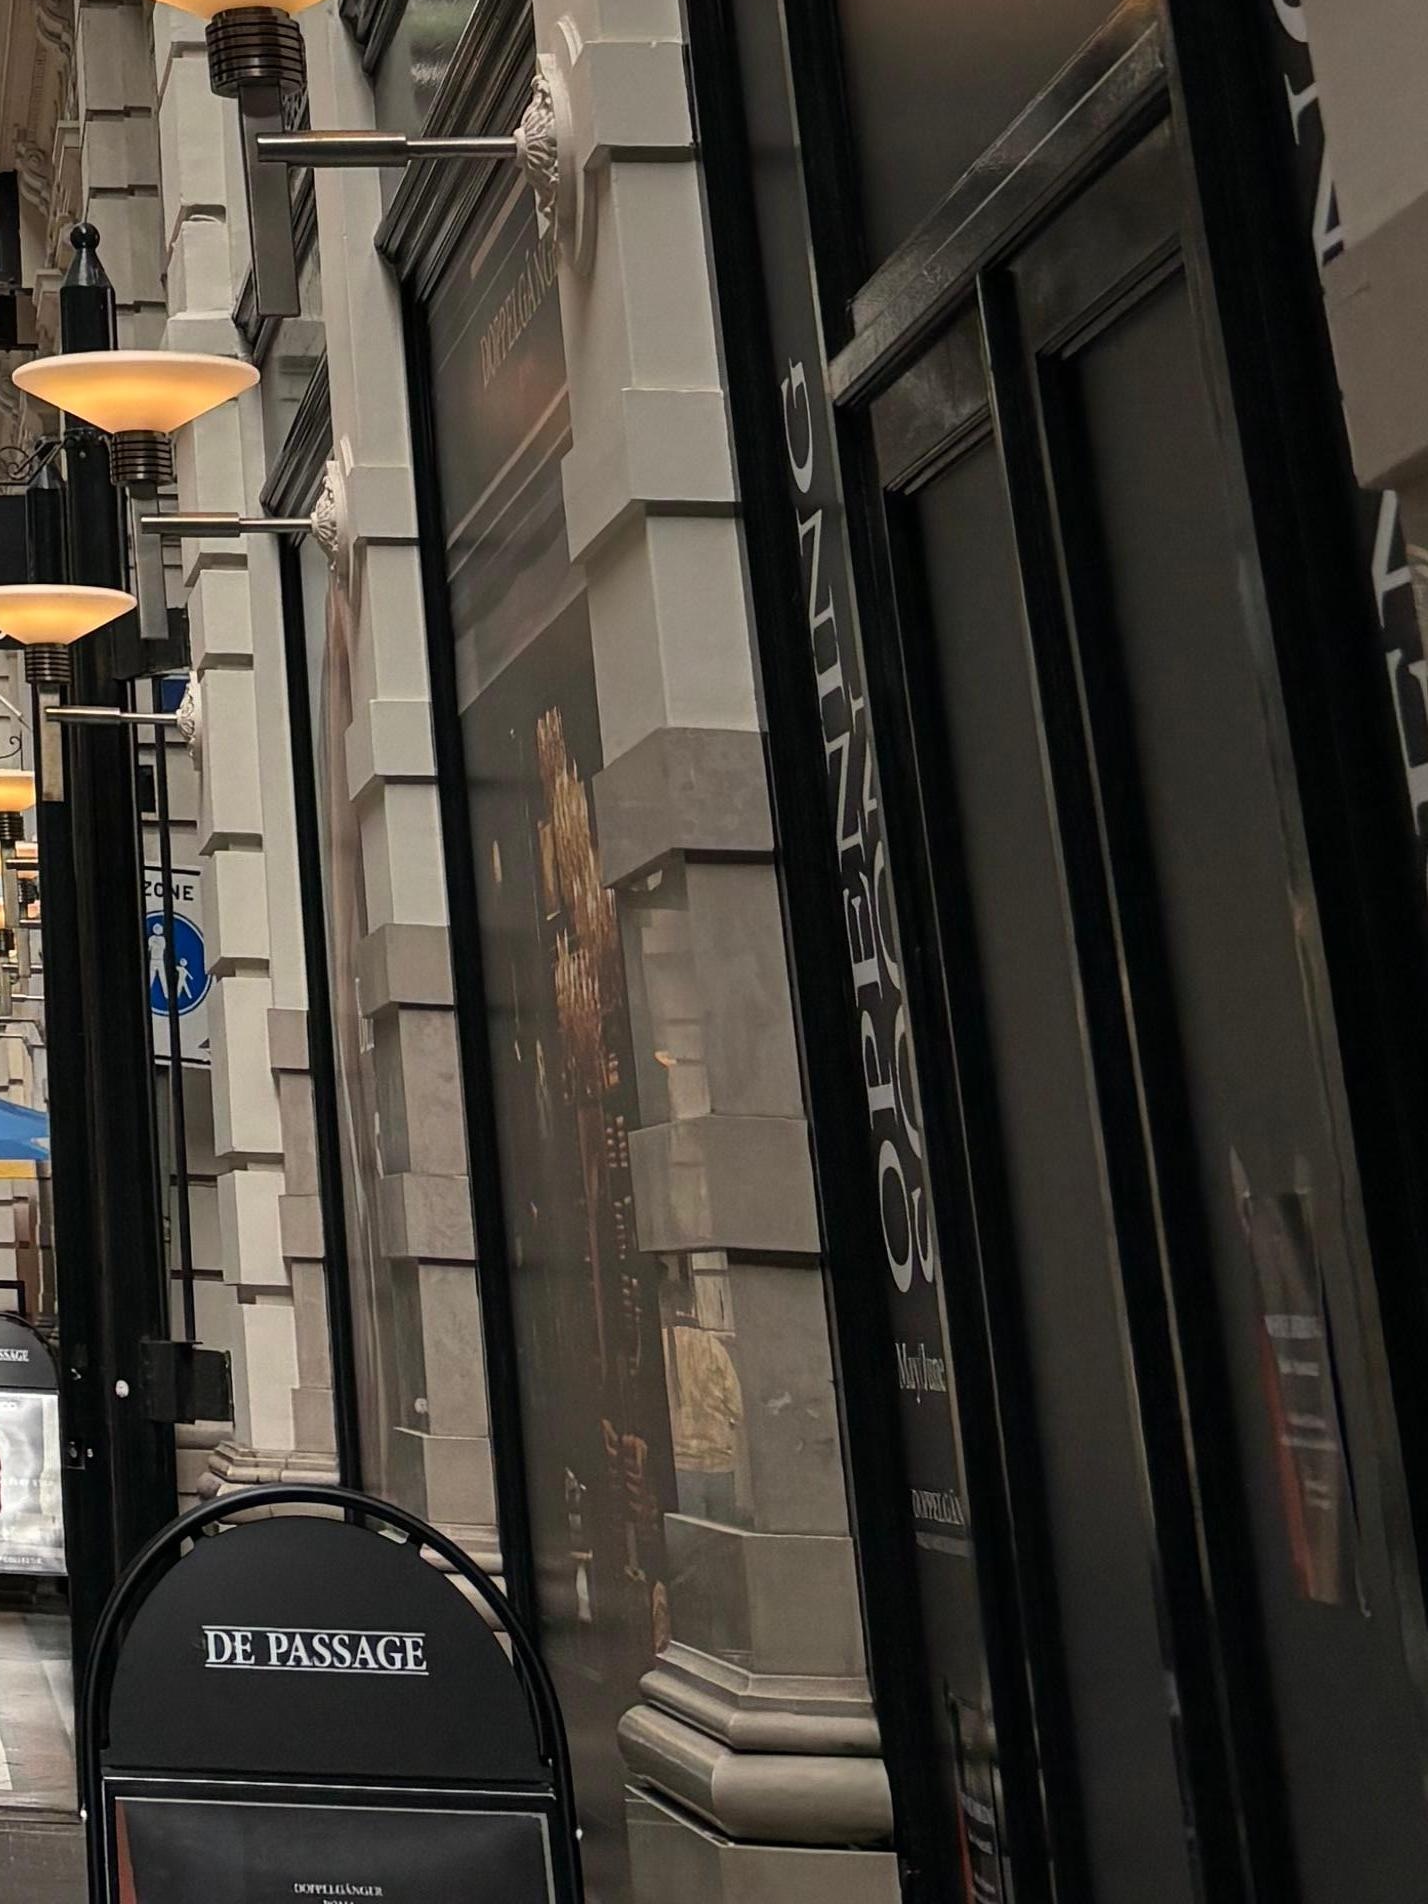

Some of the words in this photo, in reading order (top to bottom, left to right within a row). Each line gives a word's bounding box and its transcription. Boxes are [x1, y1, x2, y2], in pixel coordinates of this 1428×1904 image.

[781, 357, 914, 1293] OPENING
[144, 881, 195, 901] ZONE
[204, 1630, 256, 1665] DE
[266, 1632, 428, 1671] PASSAGE
